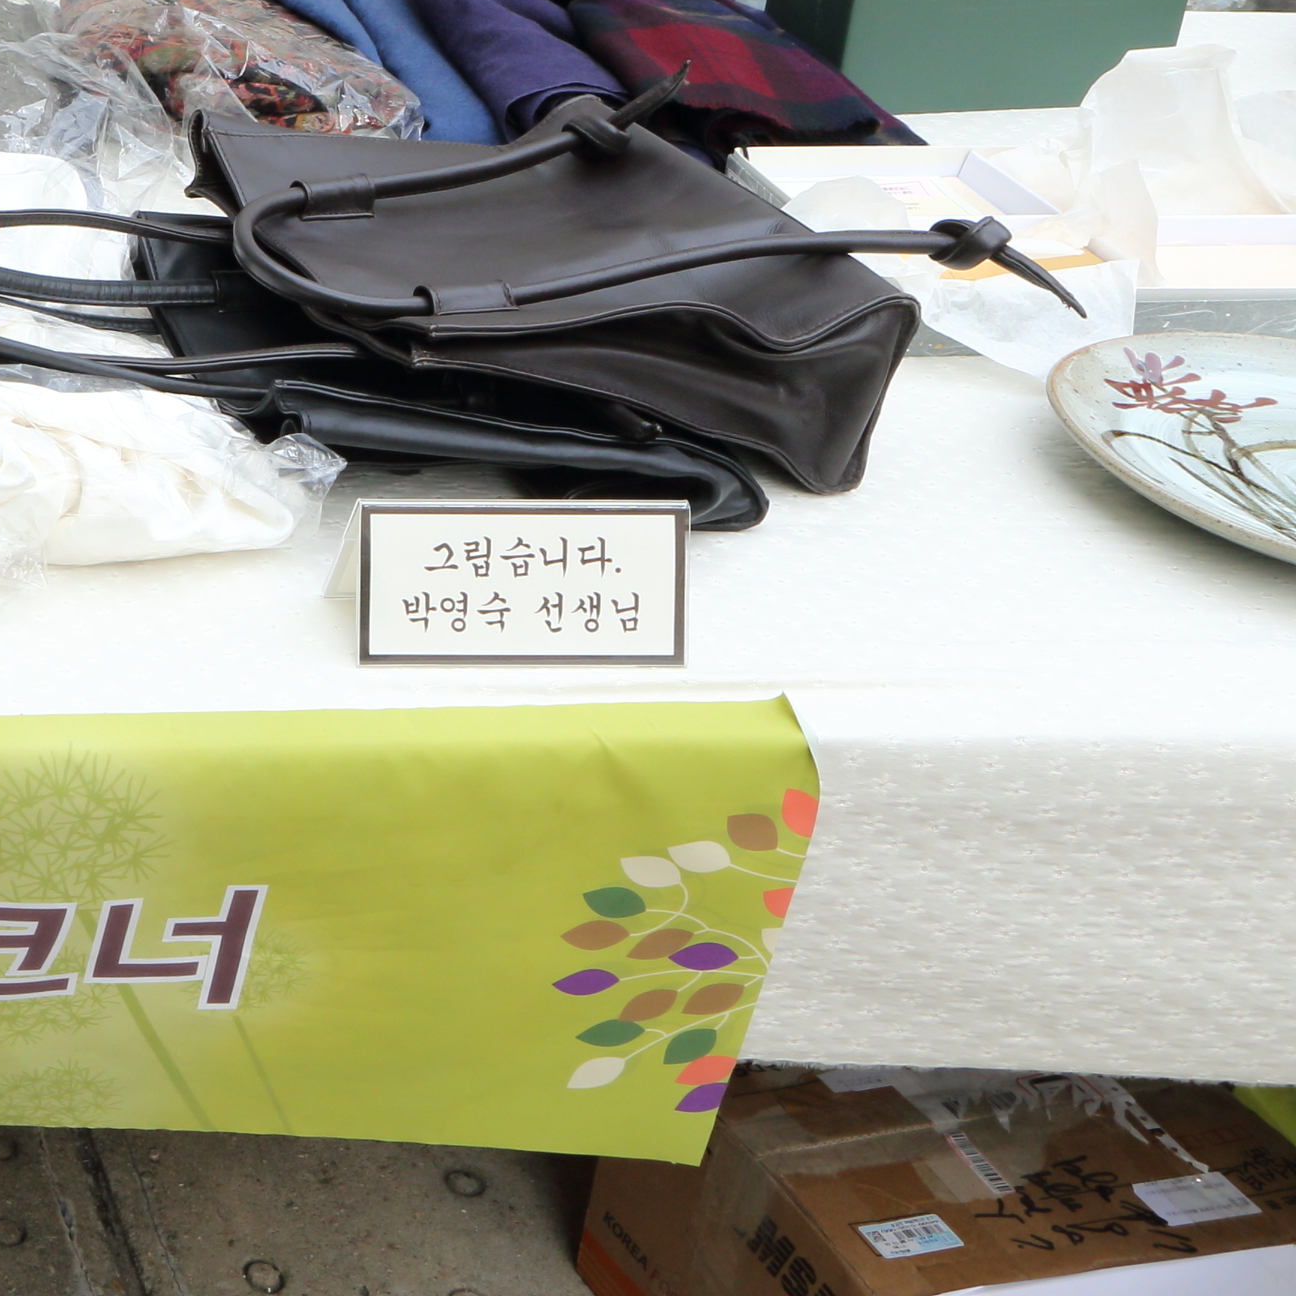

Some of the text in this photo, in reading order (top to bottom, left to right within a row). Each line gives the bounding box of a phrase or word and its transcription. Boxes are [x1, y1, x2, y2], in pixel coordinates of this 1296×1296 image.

[423, 536, 623, 579] 그립습니다.
[401, 591, 641, 634] 박영숙 선생님
[602, 1210, 650, 1272] KOREA
